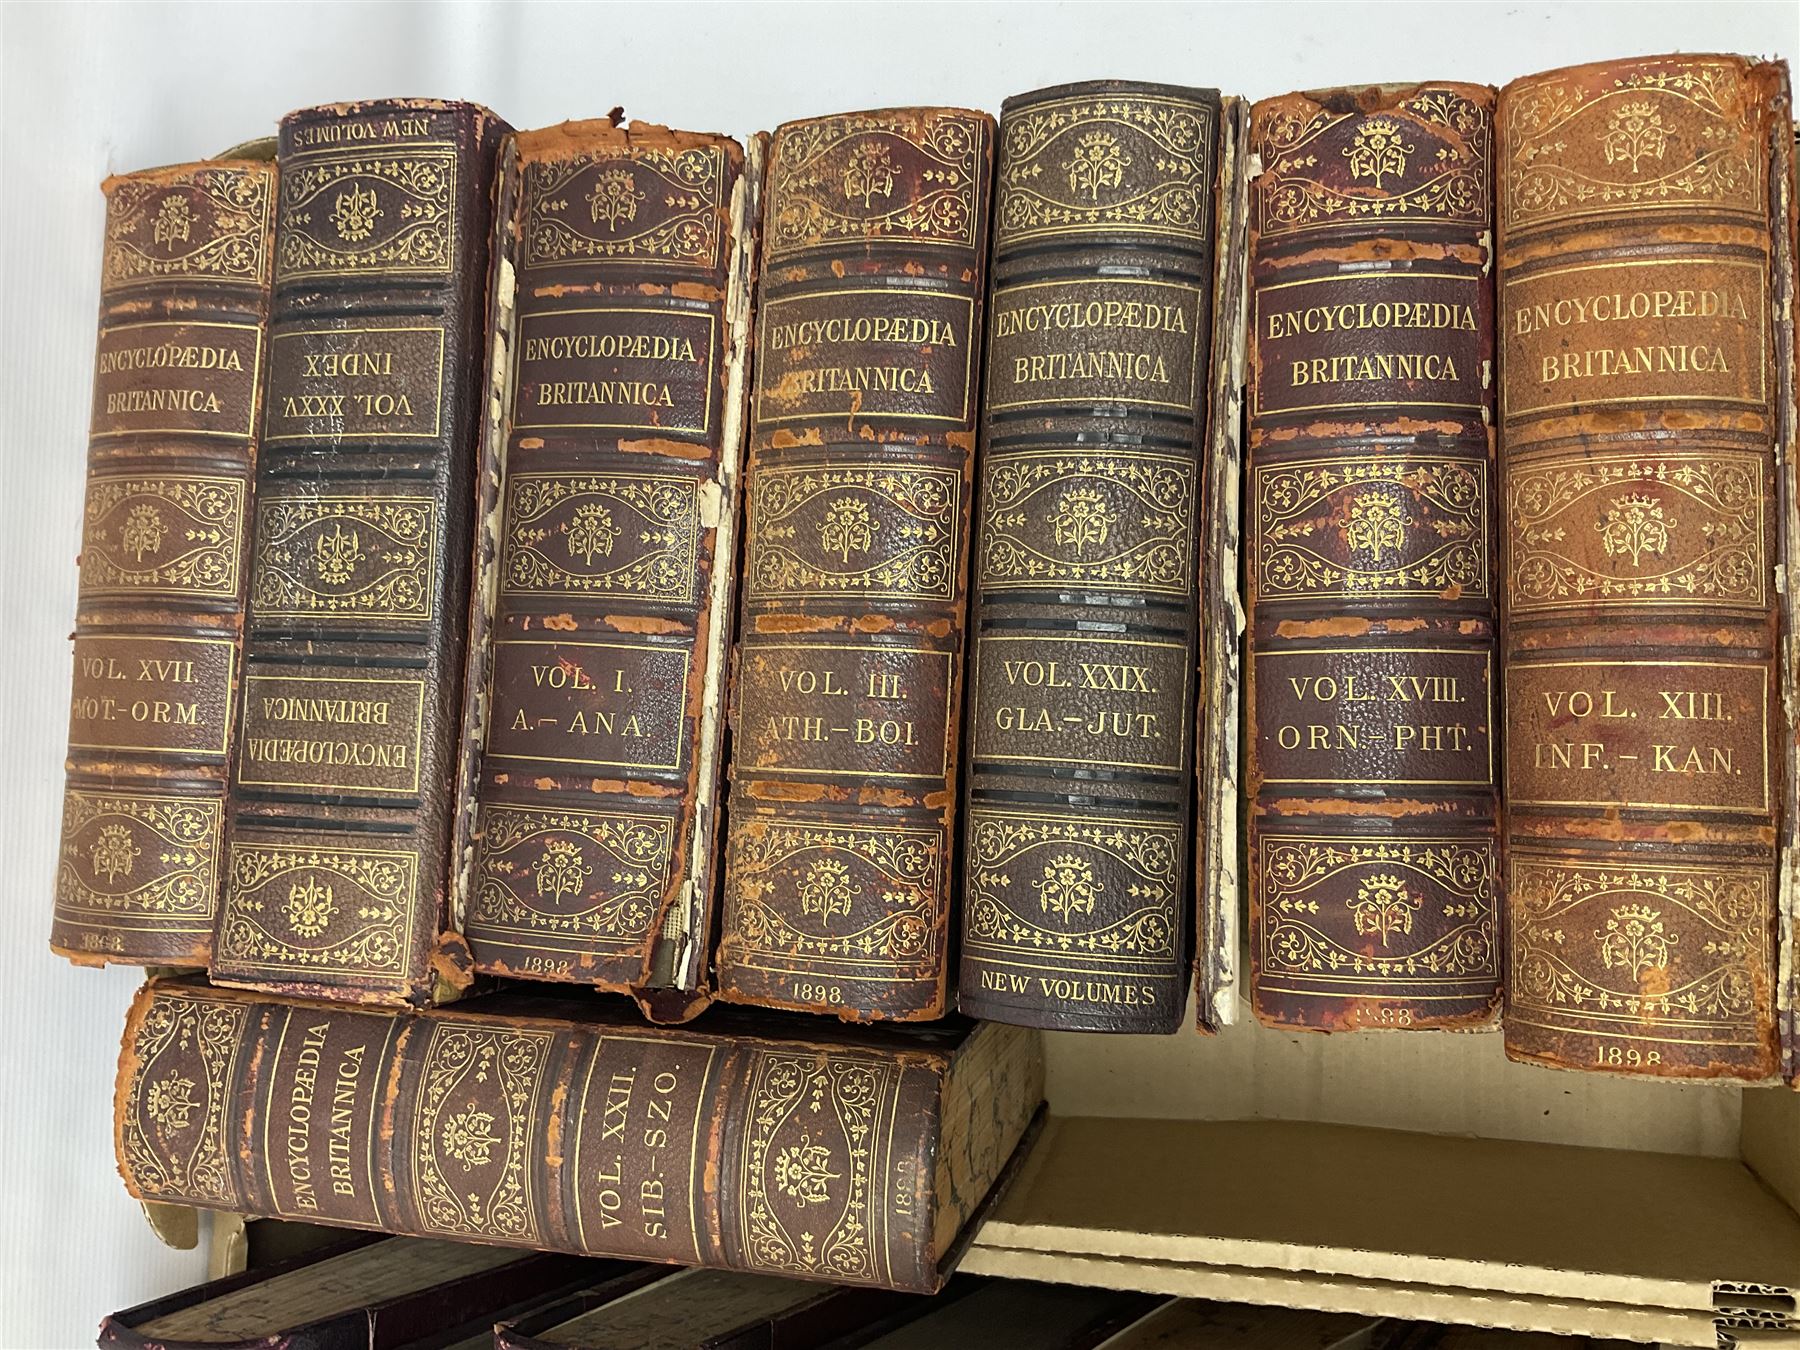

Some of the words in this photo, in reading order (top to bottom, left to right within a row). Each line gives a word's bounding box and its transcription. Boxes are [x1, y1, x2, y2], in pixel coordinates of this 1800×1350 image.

[293, 121, 377, 147] VOLUMES
[383, 118, 430, 139] NEW
[772, 317, 957, 350] ENCYCLOPÆDIA
[996, 301, 1188, 338] ENCYCLOPÆDIA
[1267, 302, 1478, 340] ENCYCLOPÆDIA
[524, 334, 697, 363] ENCYCLOPÆDIA
[302, 352, 393, 378] INDEX
[1013, 352, 1169, 384] BRITANNICA
[1290, 354, 1459, 388] BRITANNICA
[1541, 345, 1729, 384] BRITANNICA
[106, 390, 222, 415] BRITANNICA
[536, 381, 675, 408] BRITANNICA
[82, 656, 127, 682] VOL.
[136, 660, 200, 685] XVII.
[530, 665, 597, 690] VOL.
[613, 669, 634, 693] I.
[779, 670, 848, 696] VOL.
[865, 673, 908, 700] III.
[1004, 661, 1072, 689] VOL.
[1078, 664, 1158, 694] XXIX.
[1288, 675, 1376, 703] VOL.
[1387, 675, 1466, 704] XVIII.
[262, 696, 389, 726] BRITANNICA
[1542, 690, 1638, 719] VOL.
[1657, 691, 1732, 721] XIII.
[248, 737, 407, 769] ENCYCLOPÆDIA
[980, 970, 1031, 993] NEW
[1038, 977, 1156, 1006] VOLUMES
[1597, 1046, 1662, 1067] 1898
[287, 1021, 331, 1212] ENCYCLOPÆDIA
[602, 1066, 637, 1142] XXII.
[331, 1043, 366, 1198] BRITANNICA
[598, 1154, 624, 1230] VOL.
